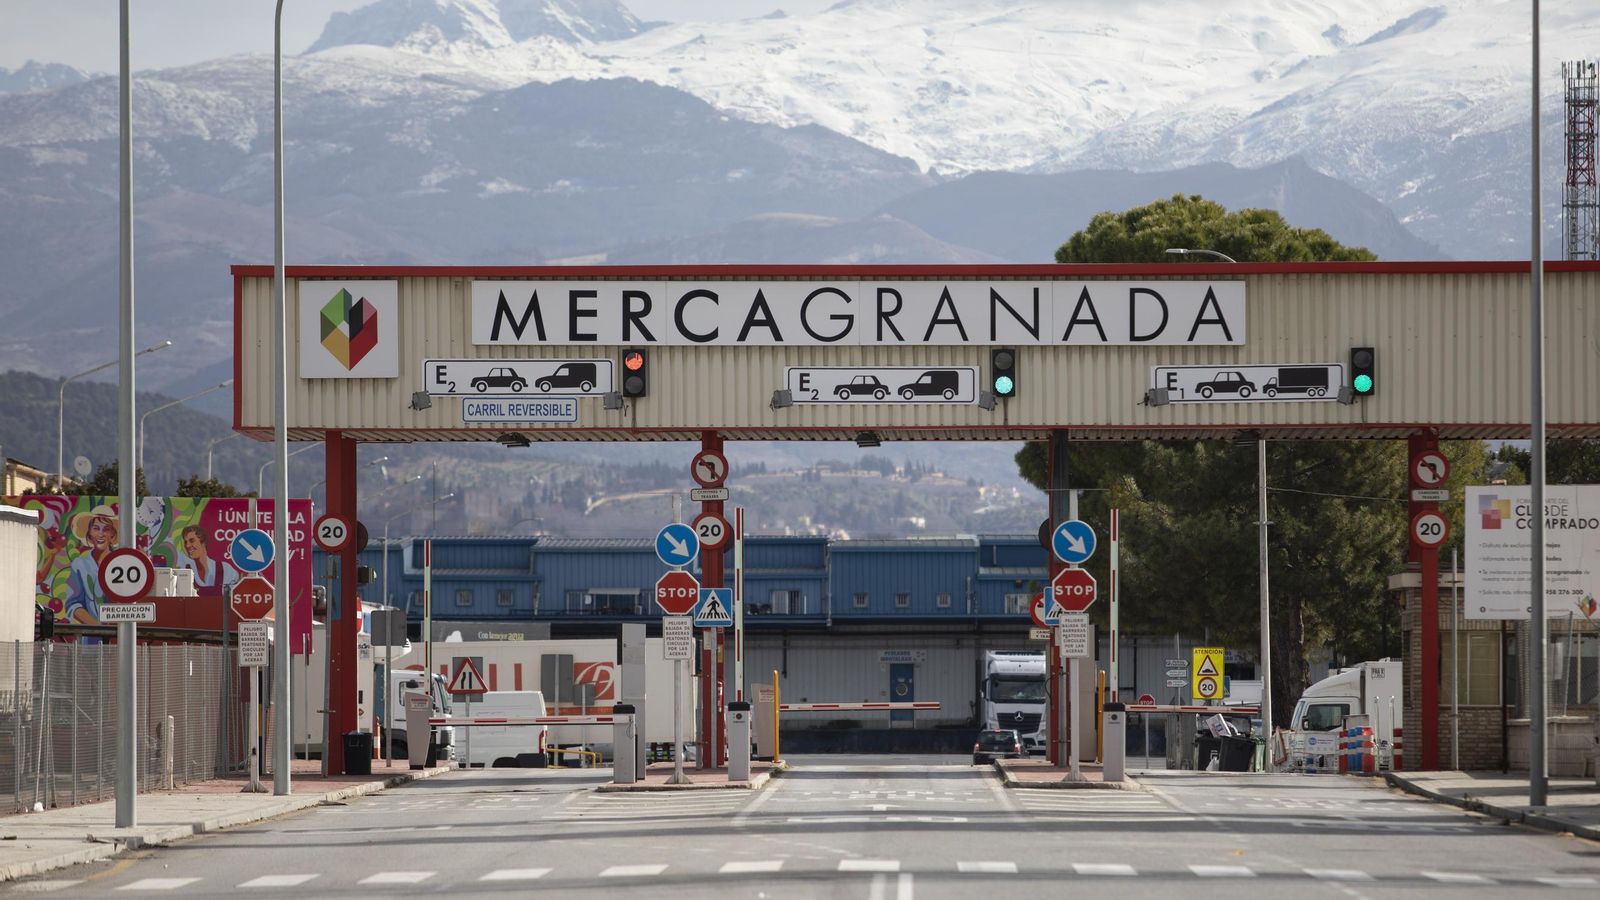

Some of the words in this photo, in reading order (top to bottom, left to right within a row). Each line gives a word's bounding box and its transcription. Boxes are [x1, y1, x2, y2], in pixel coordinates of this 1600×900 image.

[490, 285, 1233, 343] MERCAGRANADA
[468, 404, 505, 416] CARRIL
[508, 404, 572, 416] REVERSIBLE
[218, 508, 272, 524] ¡ÚNTE
[322, 526, 343, 538] 20
[700, 524, 721, 537] 20
[1420, 523, 1441, 535] 20
[111, 566, 140, 584] 20
[658, 588, 696, 598] STOP
[1055, 586, 1093, 596] STOP
[234, 594, 272, 604] STOP
